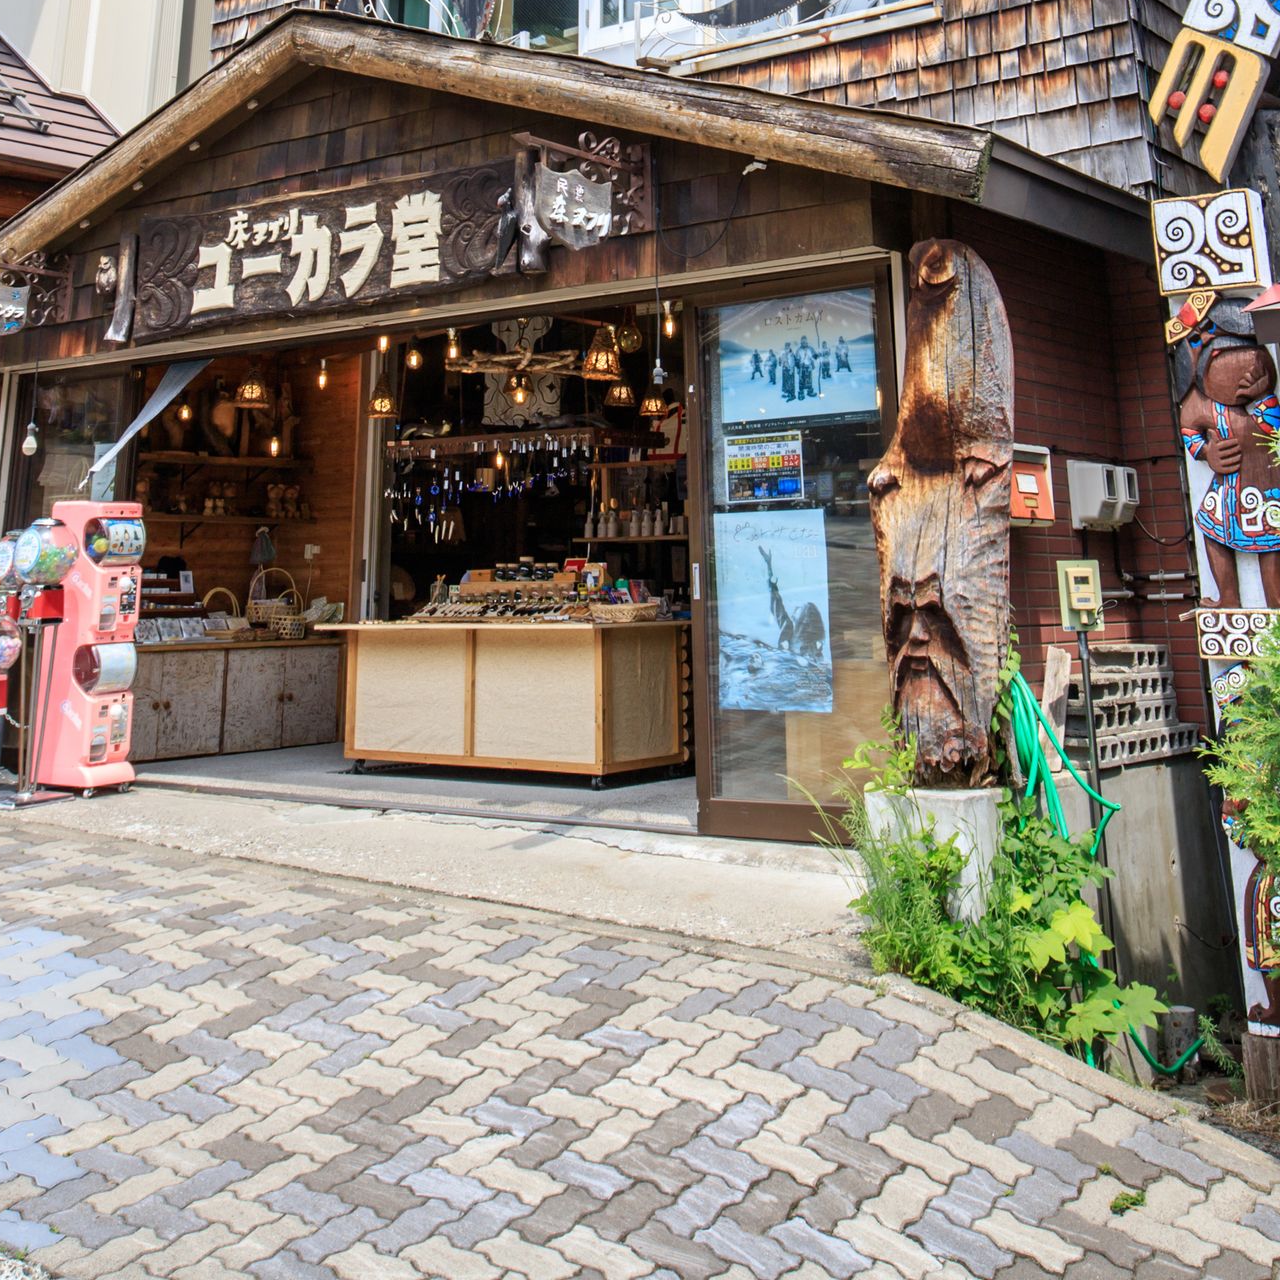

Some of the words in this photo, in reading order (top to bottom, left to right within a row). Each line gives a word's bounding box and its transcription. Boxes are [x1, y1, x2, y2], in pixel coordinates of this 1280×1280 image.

[190, 189, 443, 315] ユーカラ堂
